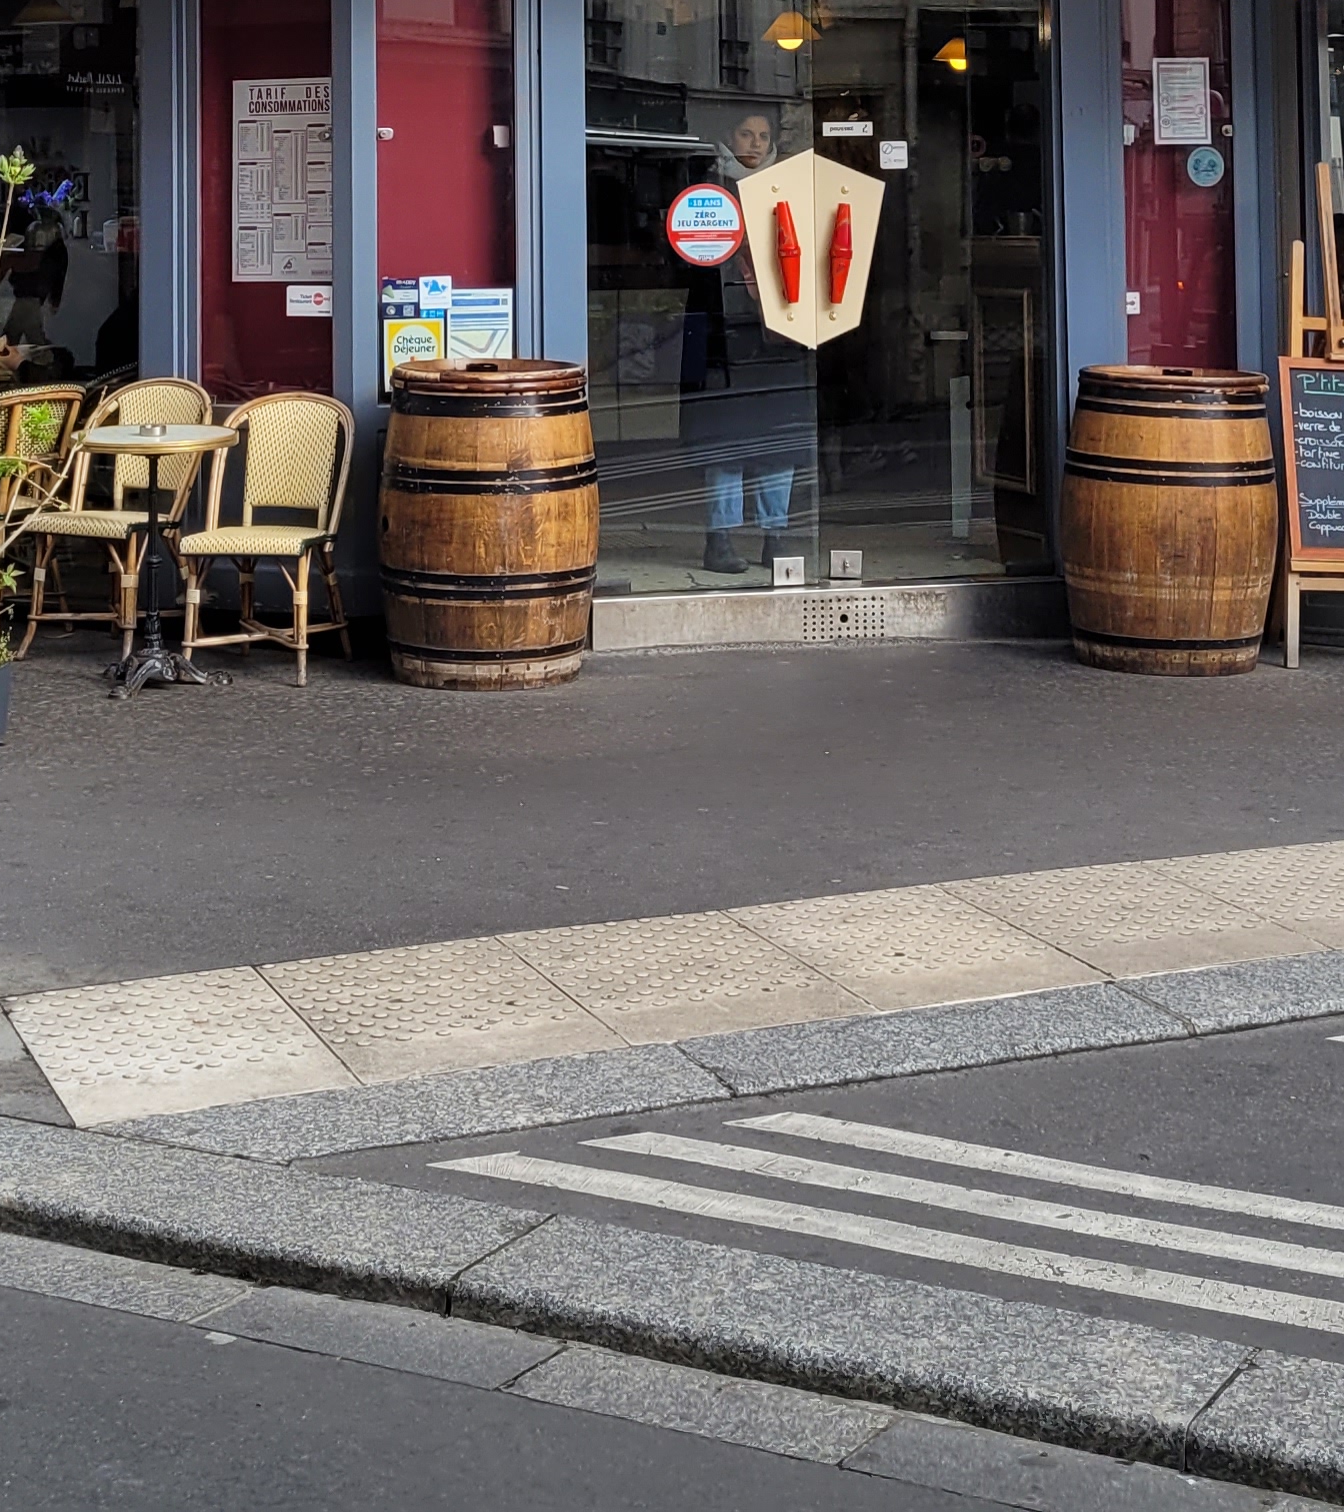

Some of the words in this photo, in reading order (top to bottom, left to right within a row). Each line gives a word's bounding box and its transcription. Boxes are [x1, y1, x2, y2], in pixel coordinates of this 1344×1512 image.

[249, 87, 287, 101] TARIF
[305, 86, 330, 99] DES
[248, 99, 331, 113] CONSOMMATIONS
[703, 198, 721, 206] ANS
[694, 210, 717, 219] ZÉRO
[677, 219, 692, 227] JEU
[693, 219, 734, 227] D'ARGENT
[396, 335, 433, 346] Chèque
[394, 343, 436, 355] Déjeuner
[1328, 420, 1342, 433] de
[1305, 508, 1342, 520] Double
